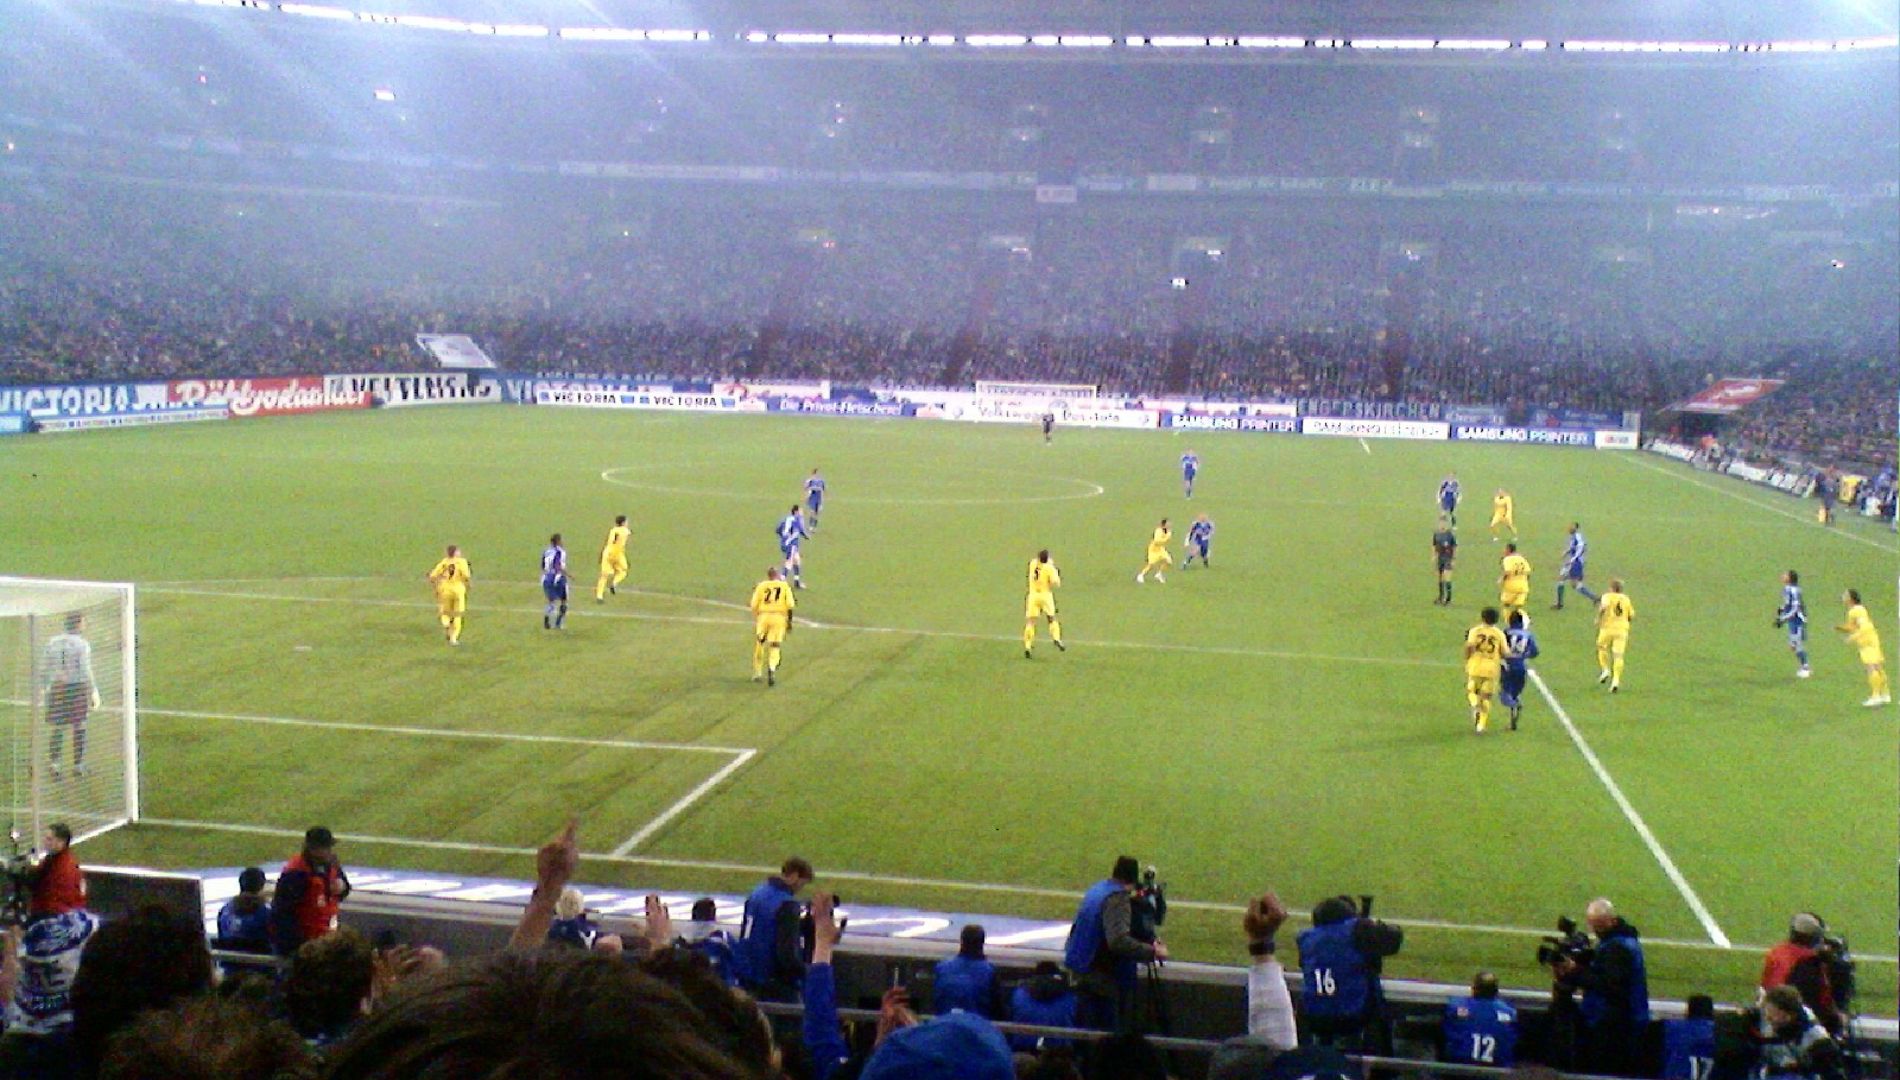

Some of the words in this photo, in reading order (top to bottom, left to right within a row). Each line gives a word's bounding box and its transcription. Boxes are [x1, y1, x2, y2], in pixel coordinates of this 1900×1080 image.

[553, 391, 616, 405] VICTORIA
[653, 396, 717, 407] VICTORIA
[1457, 426, 1526, 440] SAMSUNG
[764, 586, 781, 604] 27
[1475, 633, 1496, 654] 25
[1314, 967, 1336, 995] 16
[1471, 1032, 1496, 1063] 12
[1689, 1055, 1715, 1080] 17
